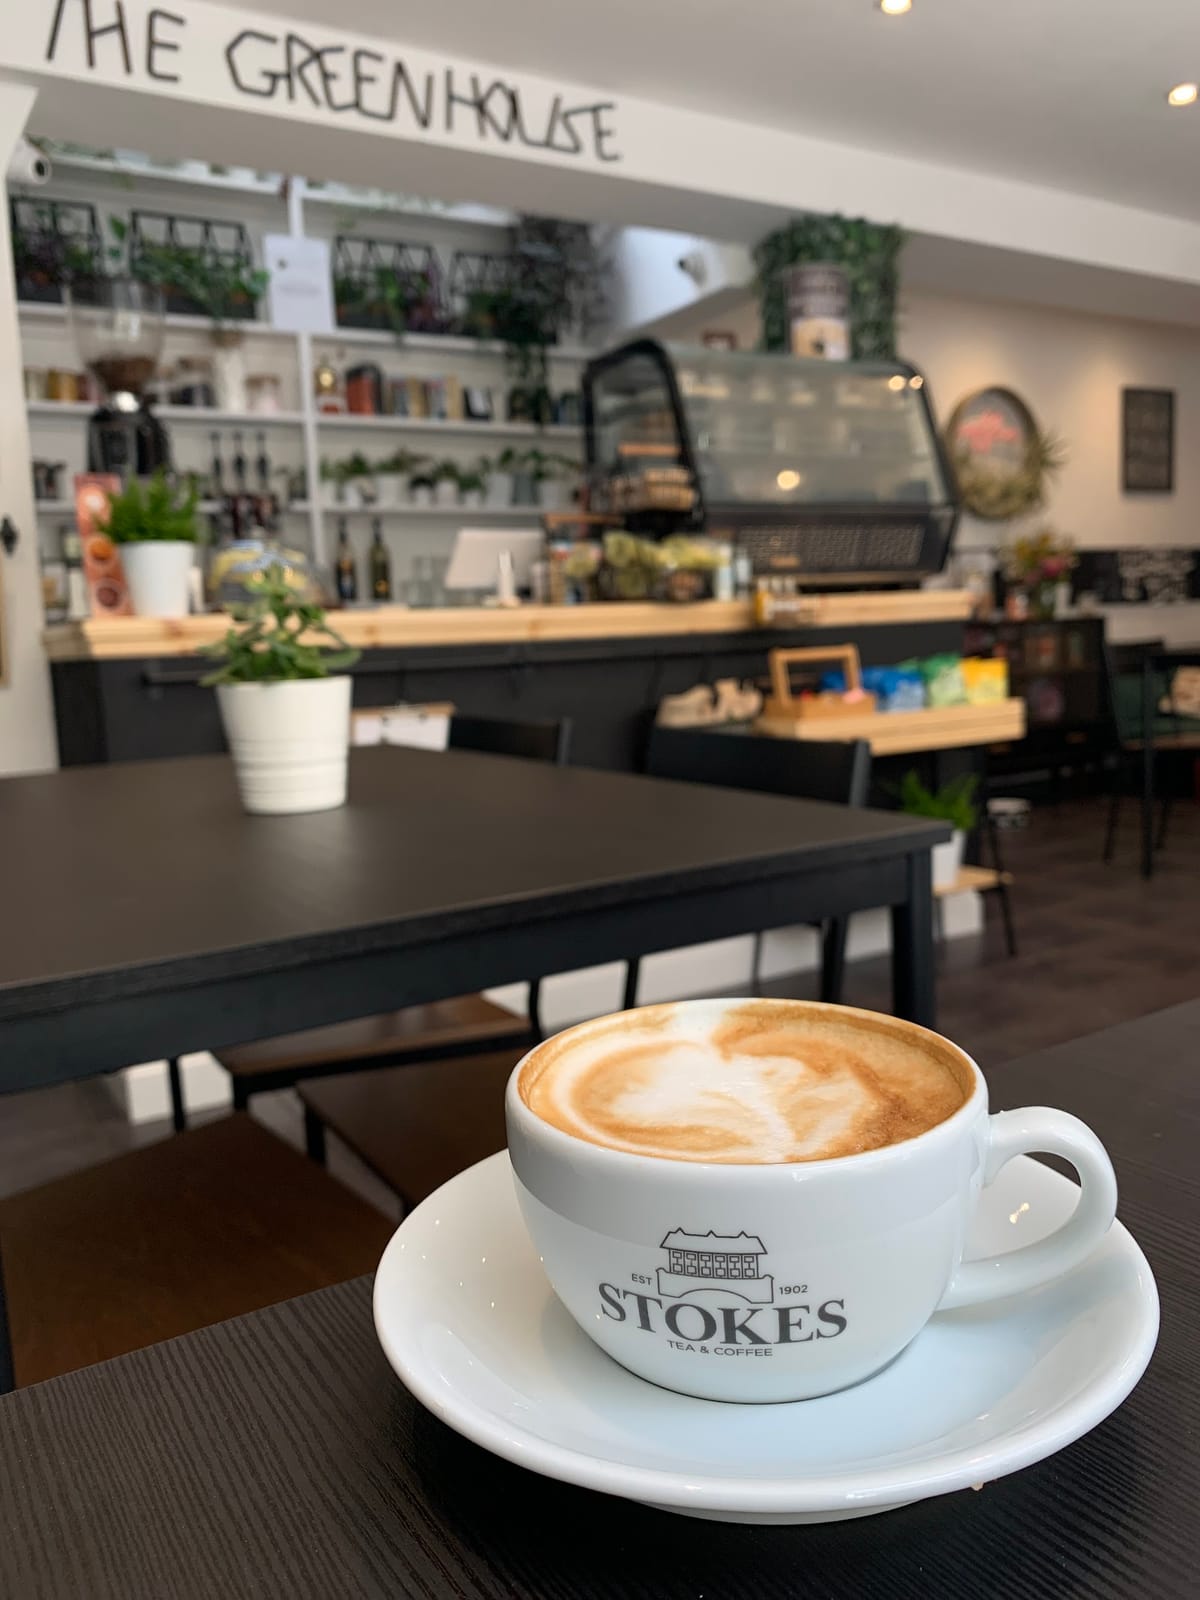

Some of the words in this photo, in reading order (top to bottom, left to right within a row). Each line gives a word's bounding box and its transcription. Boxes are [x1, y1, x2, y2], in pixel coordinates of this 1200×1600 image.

[225, 29, 621, 161] GREENHOUSE
[631, 1273, 652, 1285] EST
[779, 1284, 808, 1295] 1902
[599, 1283, 847, 1345] STOKES
[667, 1340, 696, 1352] TEA
[700, 1345, 709, 1354] &
[713, 1347, 773, 1357] COFFEE
